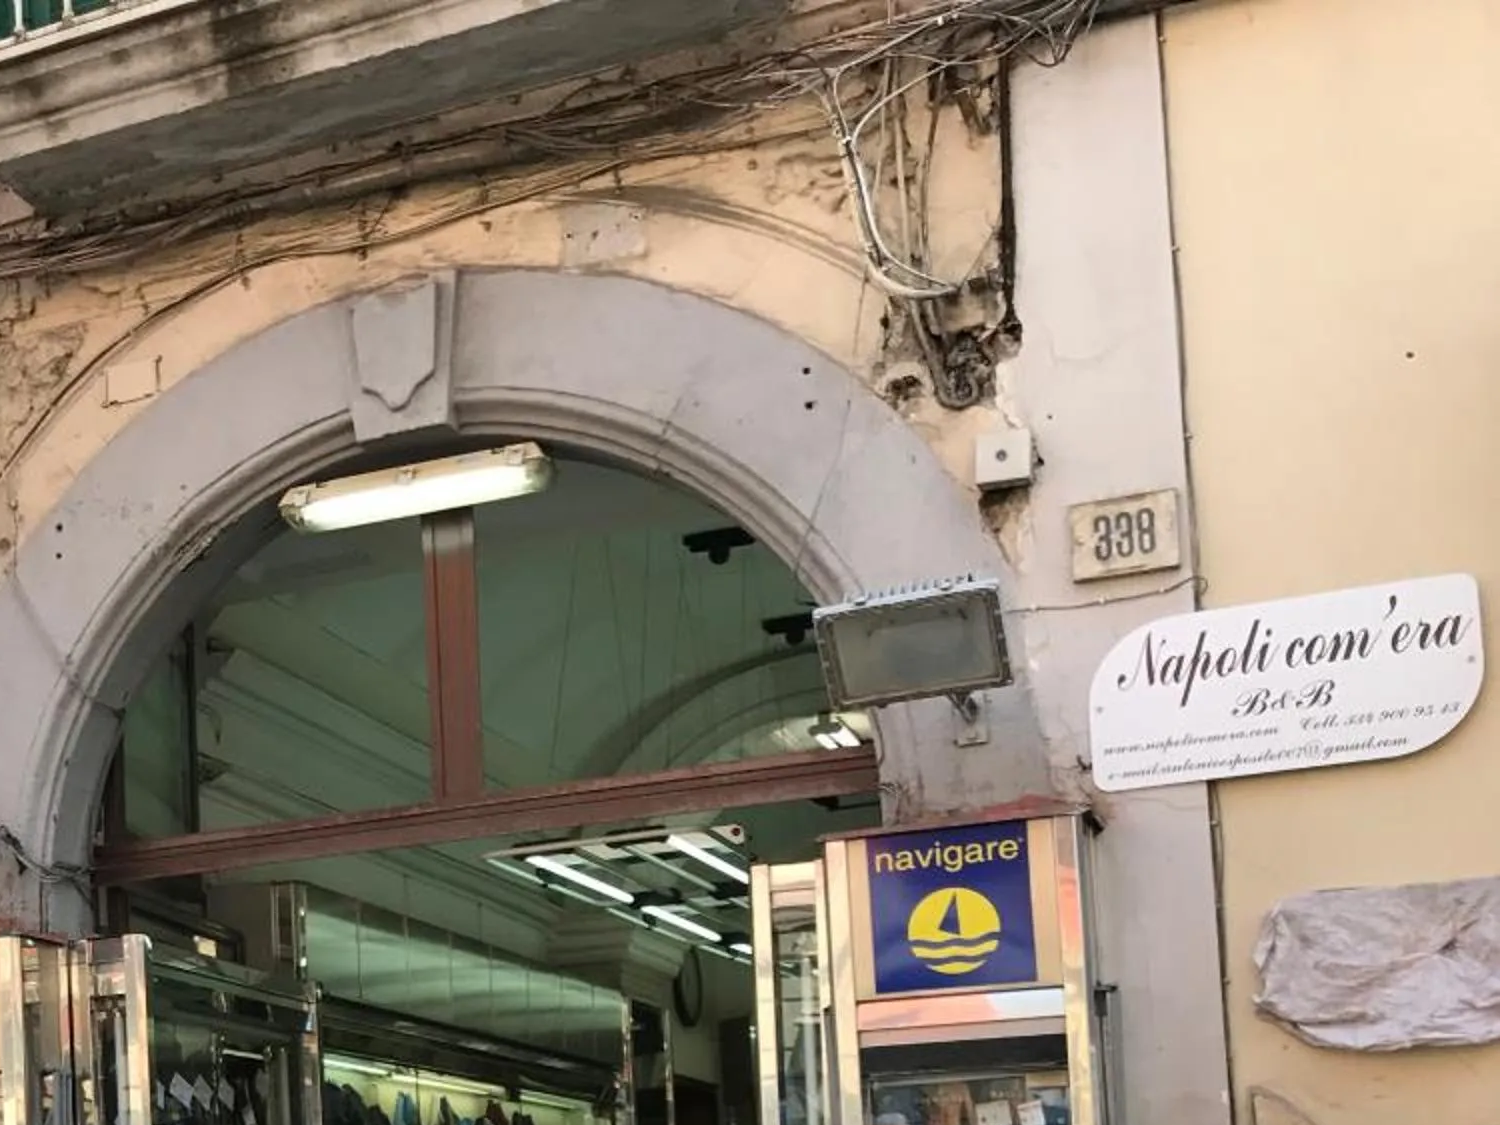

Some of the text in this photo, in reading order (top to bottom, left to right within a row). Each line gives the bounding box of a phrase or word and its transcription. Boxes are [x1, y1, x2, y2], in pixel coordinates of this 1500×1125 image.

[1093, 507, 1156, 562] 338
[1117, 595, 1472, 708] Napoli com'era
[1232, 679, 1336, 718] B&B
[875, 838, 1019, 873] navigare
